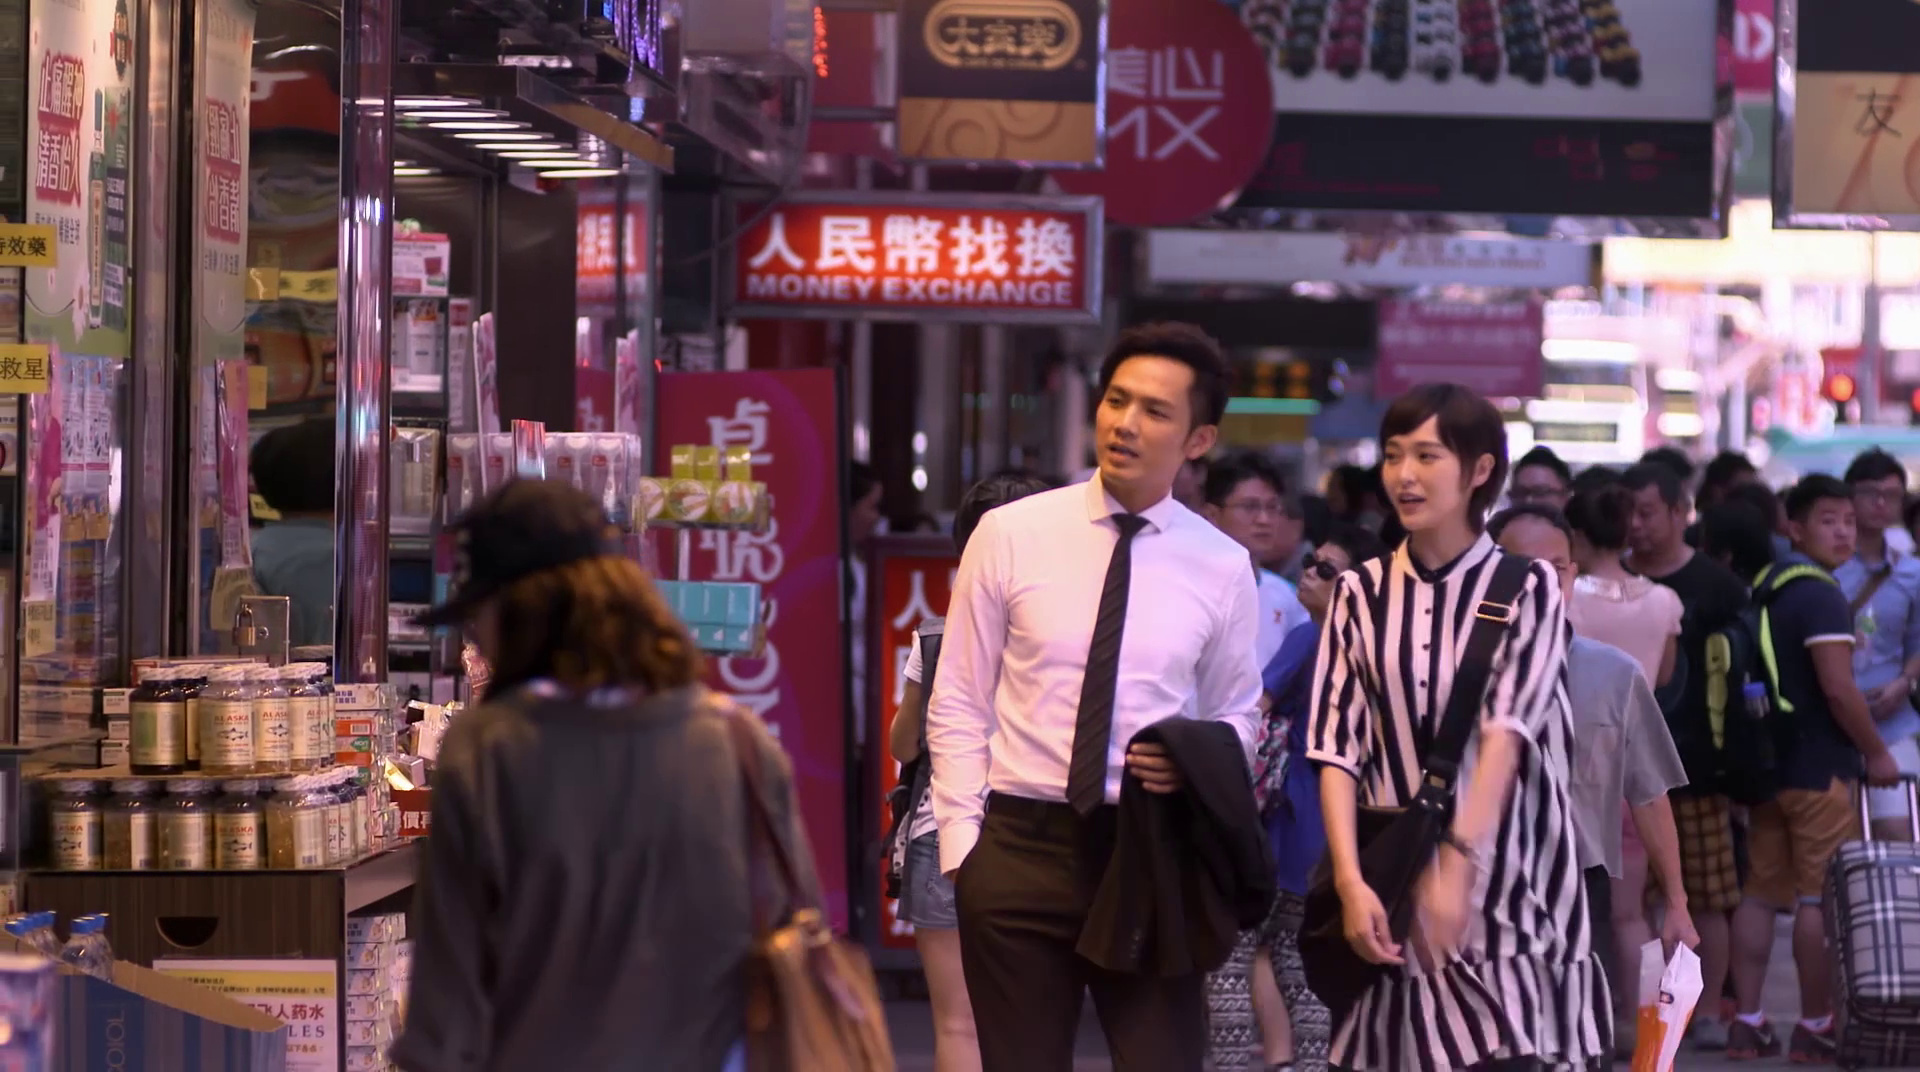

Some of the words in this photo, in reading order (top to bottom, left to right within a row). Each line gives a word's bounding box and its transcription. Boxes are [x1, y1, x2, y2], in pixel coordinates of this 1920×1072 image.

[749, 213, 1075, 277] 人民幣找換
[747, 273, 874, 300] MONEY
[883, 276, 1073, 305] EXCHANGE
[0, 357, 45, 380] 救星
